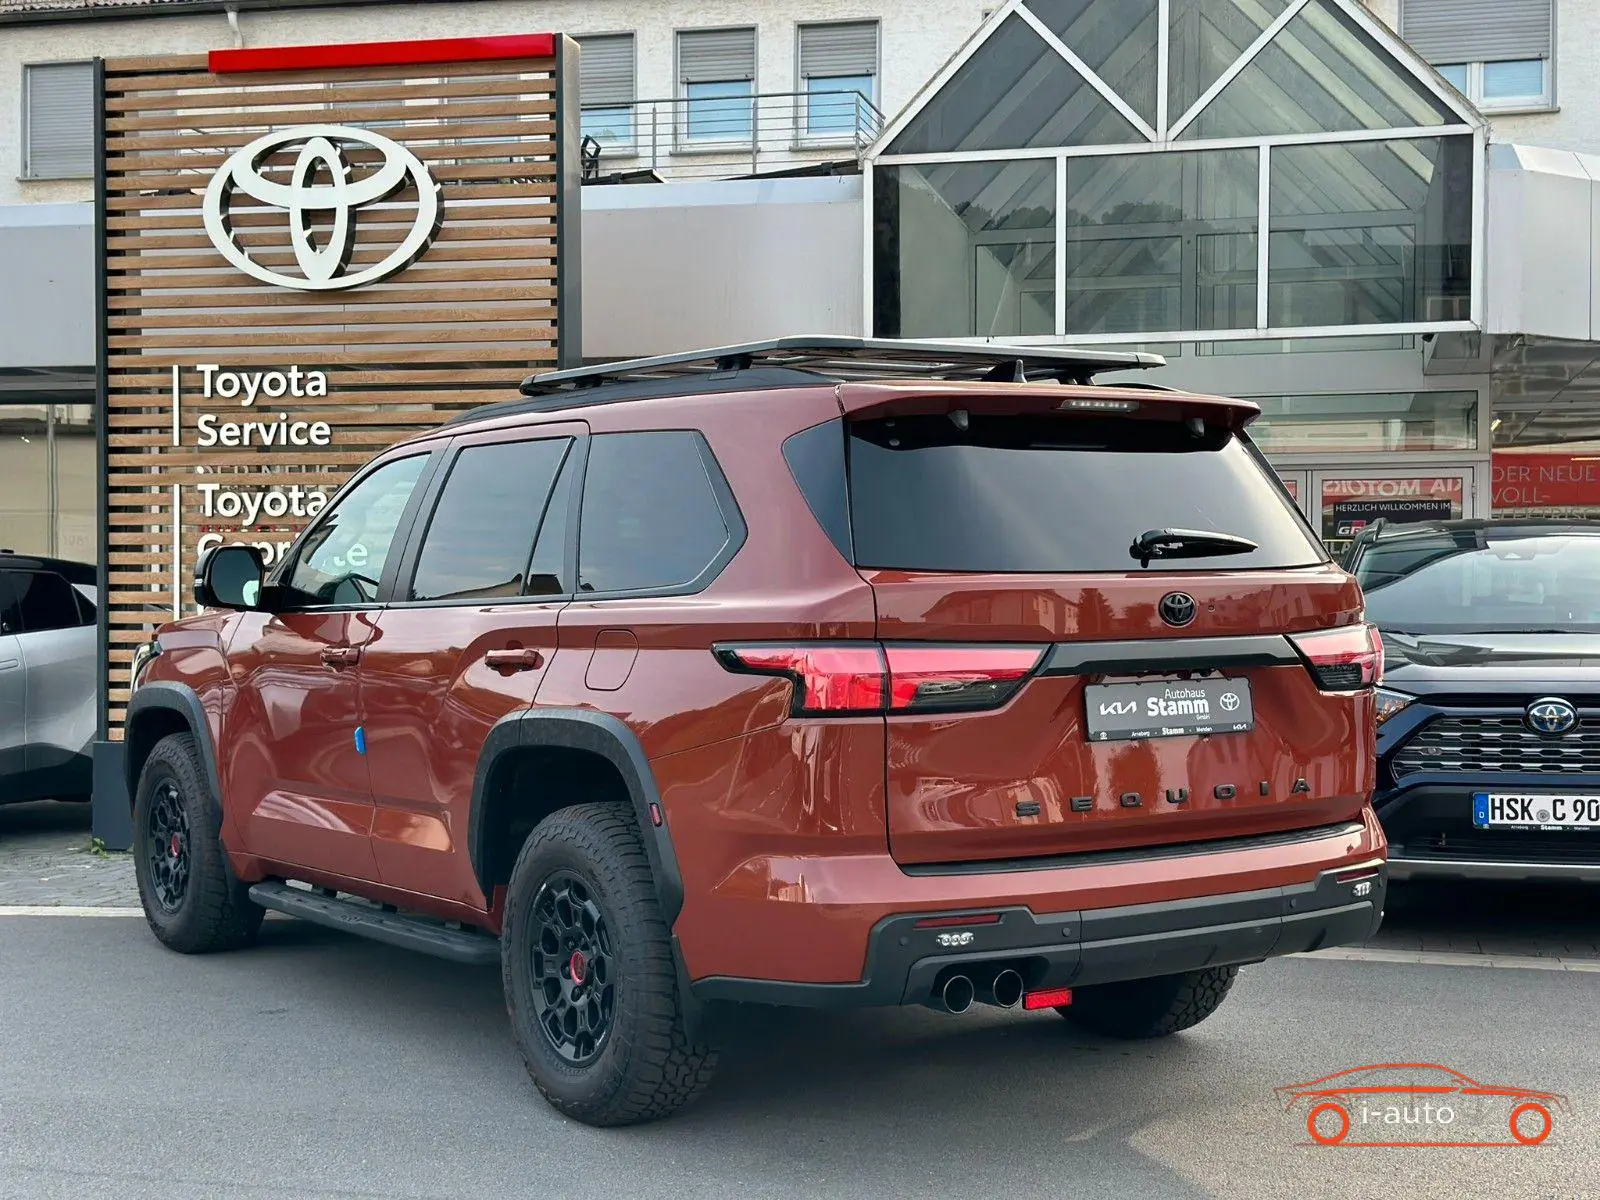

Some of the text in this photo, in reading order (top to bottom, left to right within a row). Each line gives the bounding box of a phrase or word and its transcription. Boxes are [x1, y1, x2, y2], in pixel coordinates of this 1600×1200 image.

[196, 364, 328, 406] Toyota
[196, 412, 332, 447] Service
[1492, 465, 1597, 482] DER NEUE
[196, 483, 328, 526] Toyota
[1335, 502, 1451, 512] HERZLICH WILLKOMMEN IM
[1164, 687, 1206, 699] Autohaus
[1147, 697, 1210, 717] Stamm
[1162, 727, 1185, 736] Stamm
[1015, 778, 1311, 817] SEQUOIA
[1478, 811, 1485, 819] D
[1490, 797, 1534, 821] HSK
[1552, 798, 1566, 821] C
